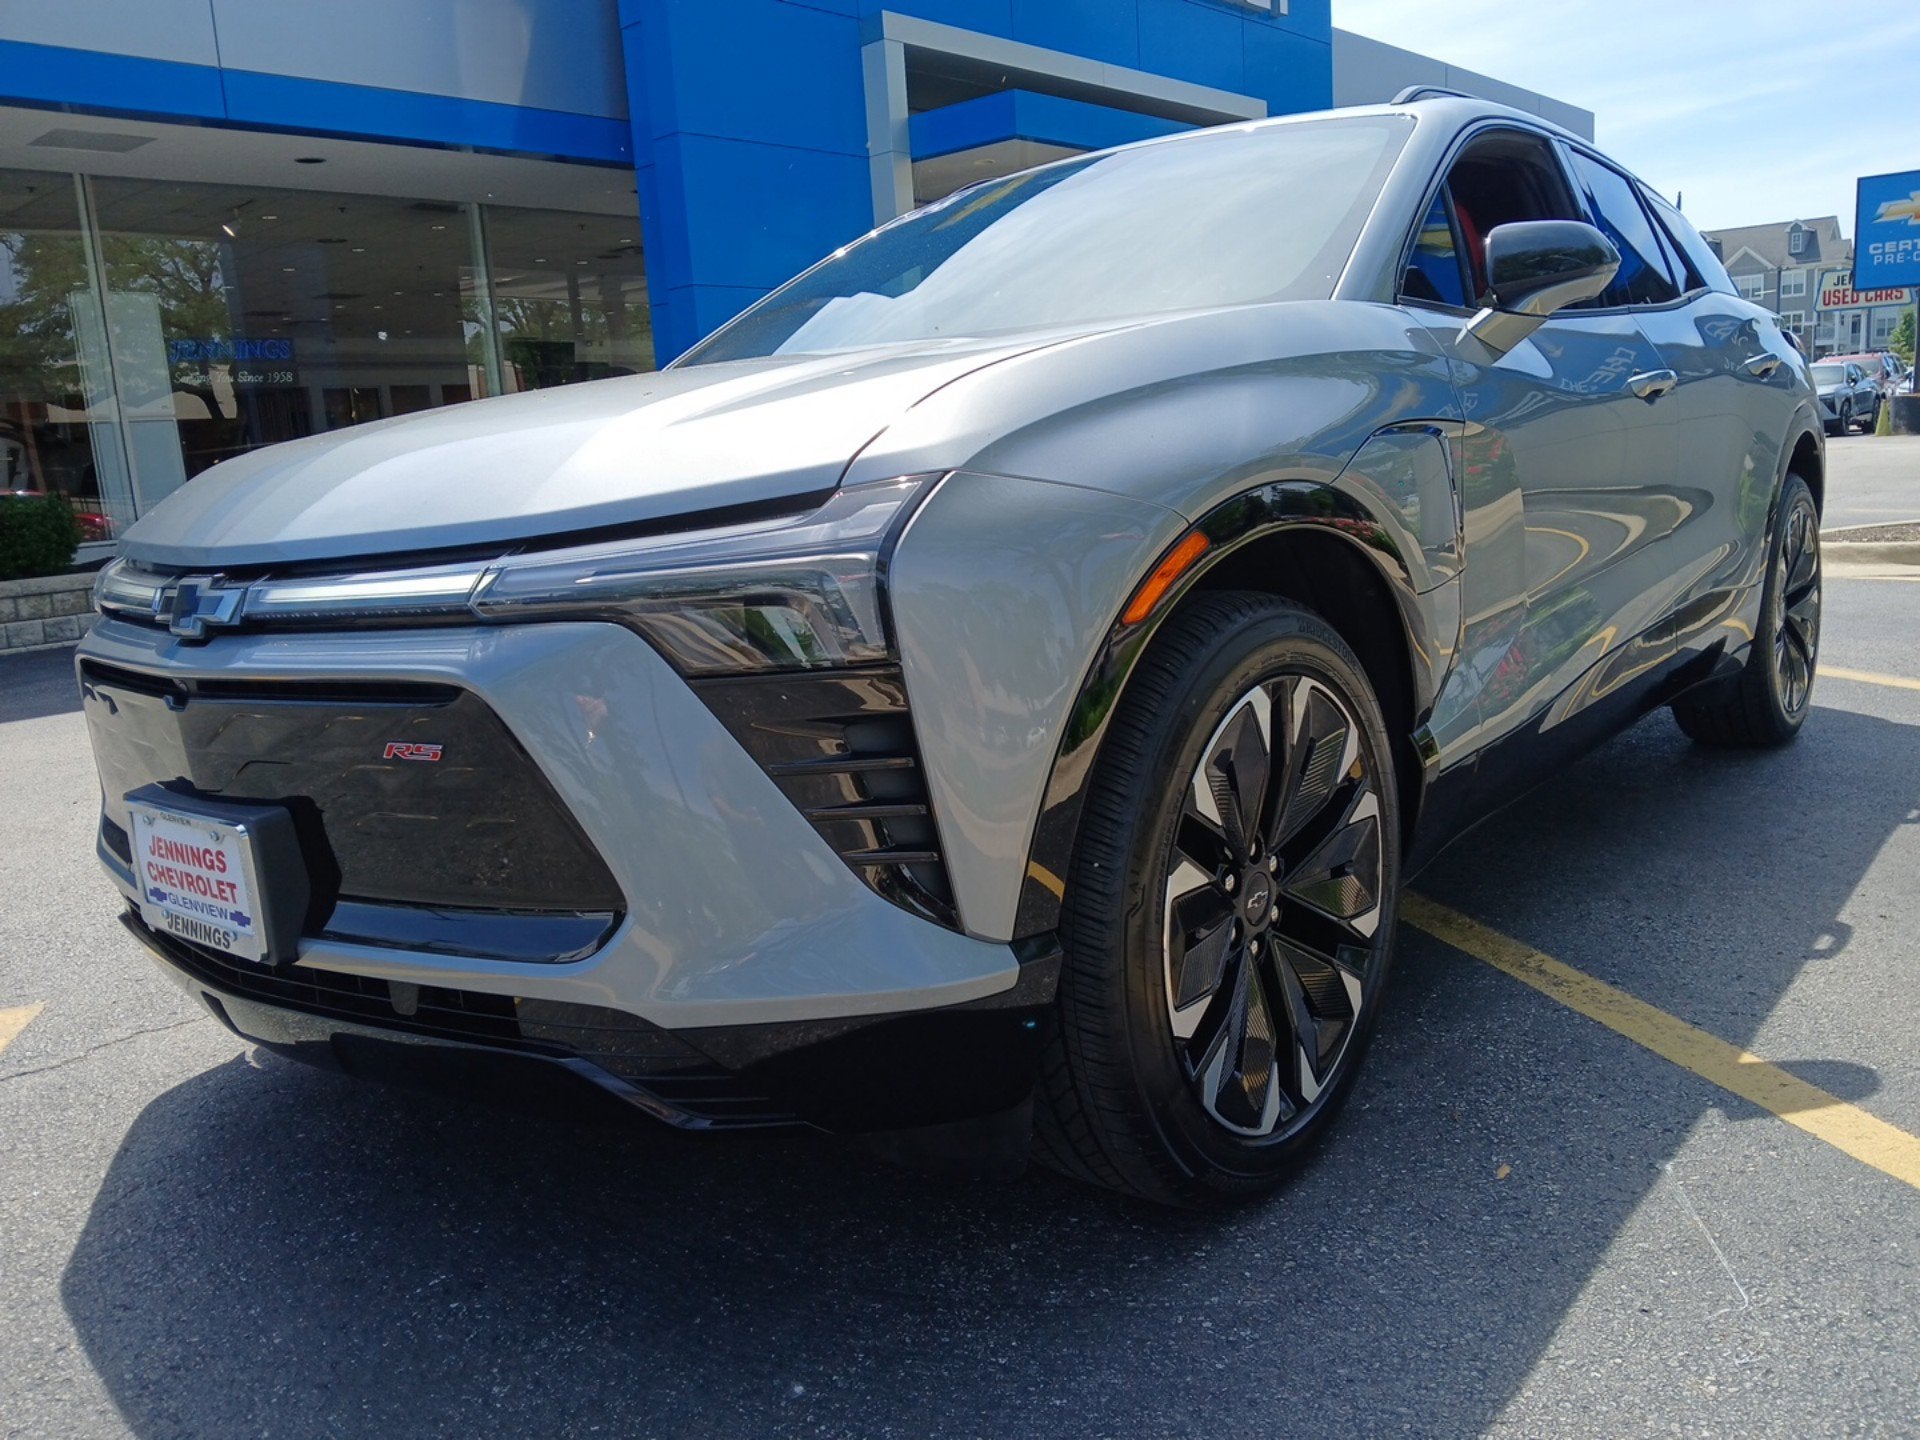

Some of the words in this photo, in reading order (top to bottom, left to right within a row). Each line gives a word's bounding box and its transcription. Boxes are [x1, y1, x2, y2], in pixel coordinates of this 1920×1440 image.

[1822, 288, 1860, 307] USED
[1864, 287, 1905, 302] CARS
[169, 339, 292, 361] JENNINGS
[238, 370, 264, 383] Since
[267, 371, 294, 383] 1958
[383, 742, 443, 761] RS
[149, 835, 227, 874] JENNINGS
[147, 861, 238, 905] CHEVROLET
[167, 892, 229, 920] GLENVIEW
[167, 912, 231, 950] JENNINGS
